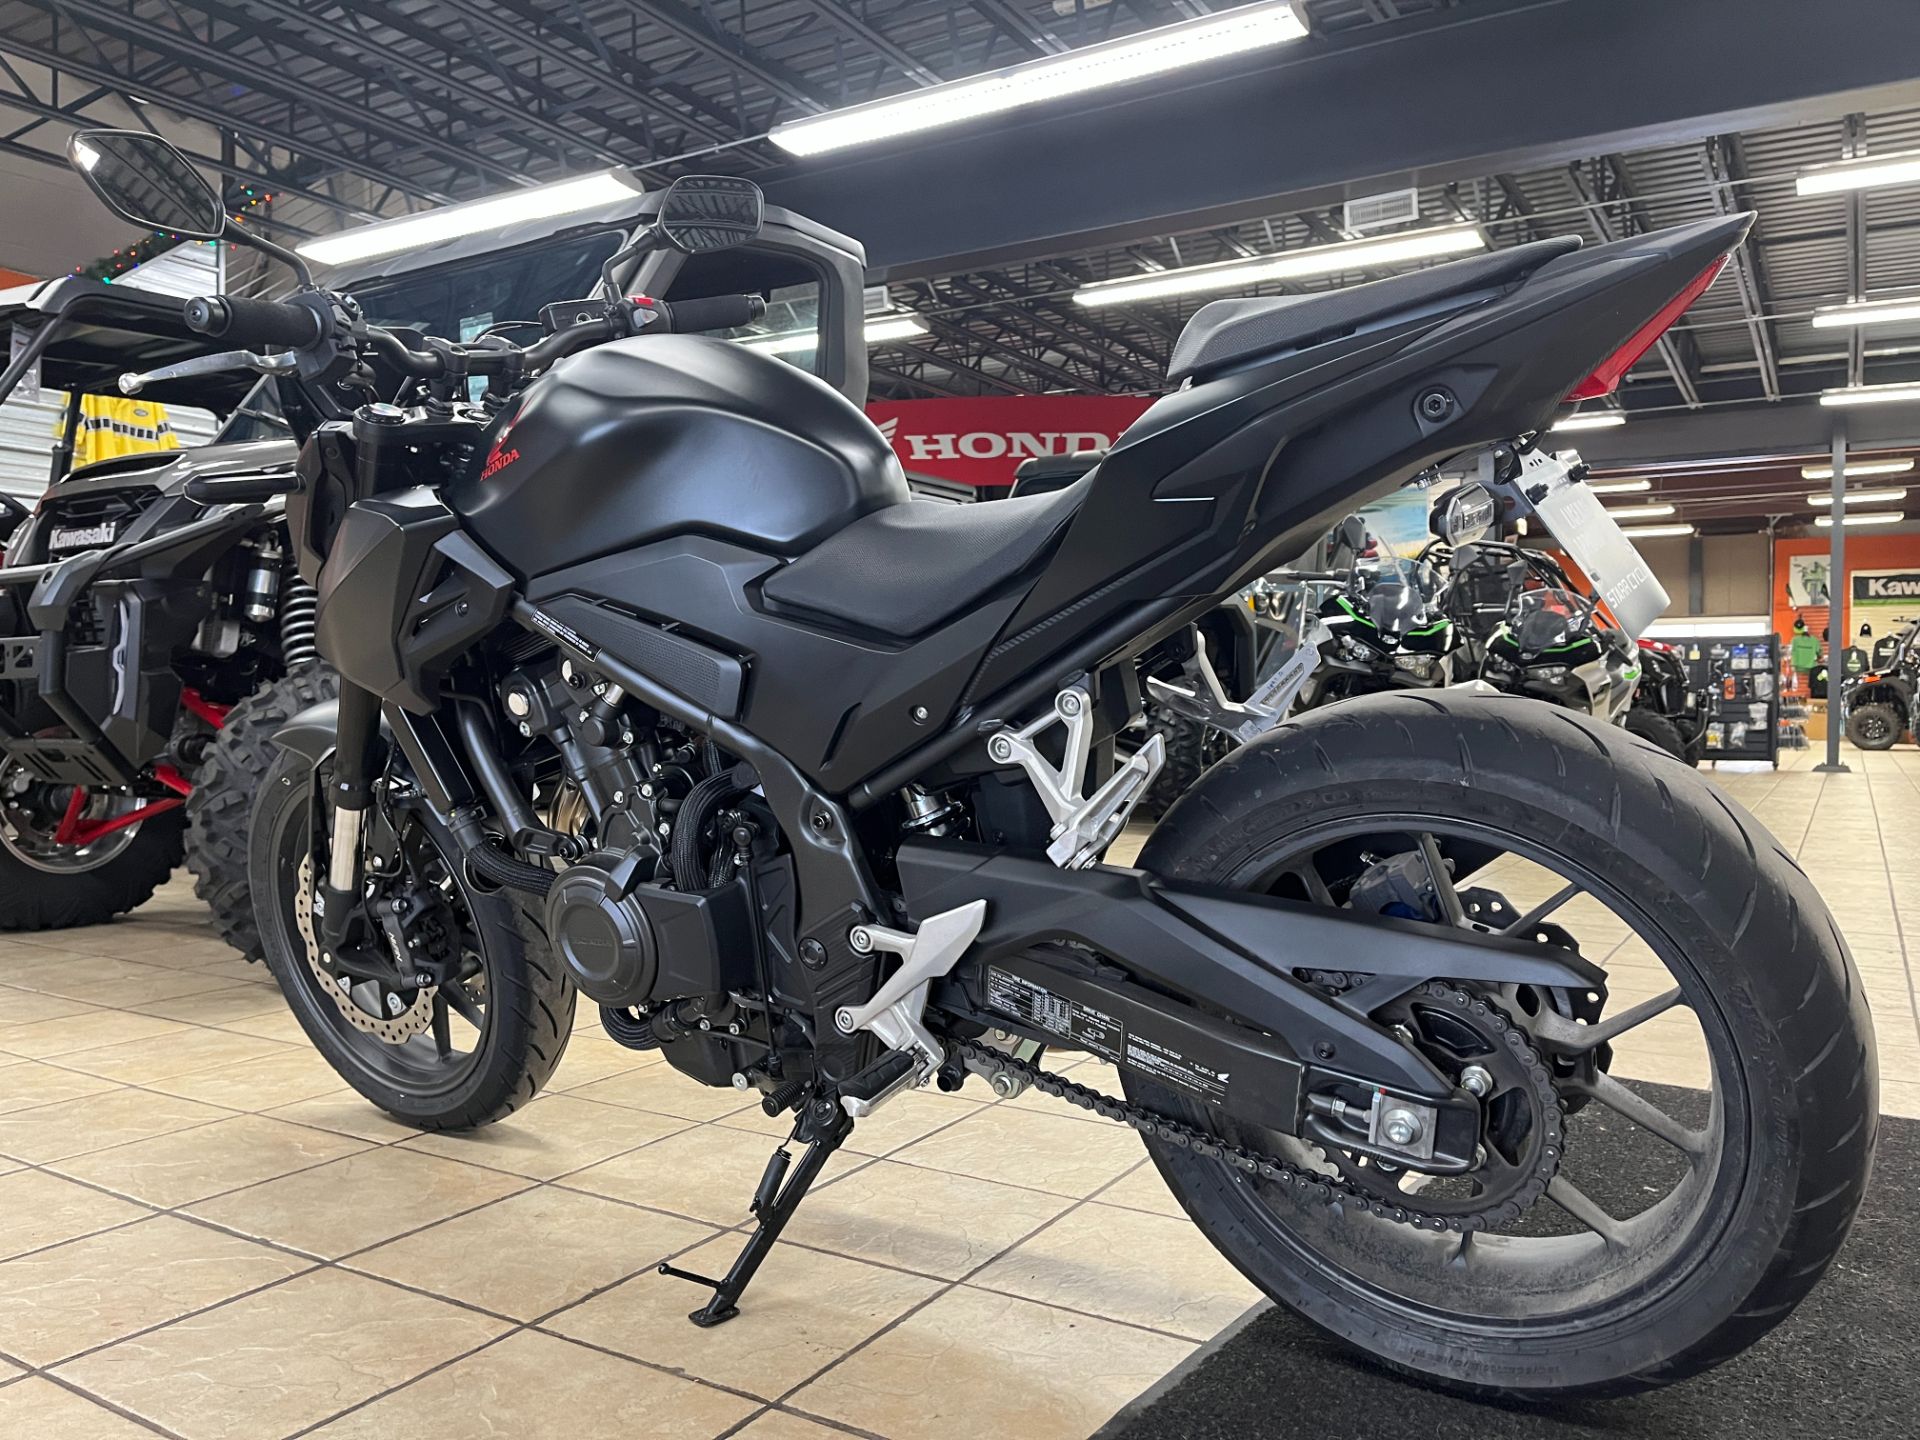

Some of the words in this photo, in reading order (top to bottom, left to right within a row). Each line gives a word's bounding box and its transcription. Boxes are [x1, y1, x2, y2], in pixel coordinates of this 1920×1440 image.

[903, 431, 1125, 460] HOND
[480, 449, 520, 481] HONDA
[48, 521, 116, 550] Kawasaki
[1868, 578, 1920, 596] Kaw
